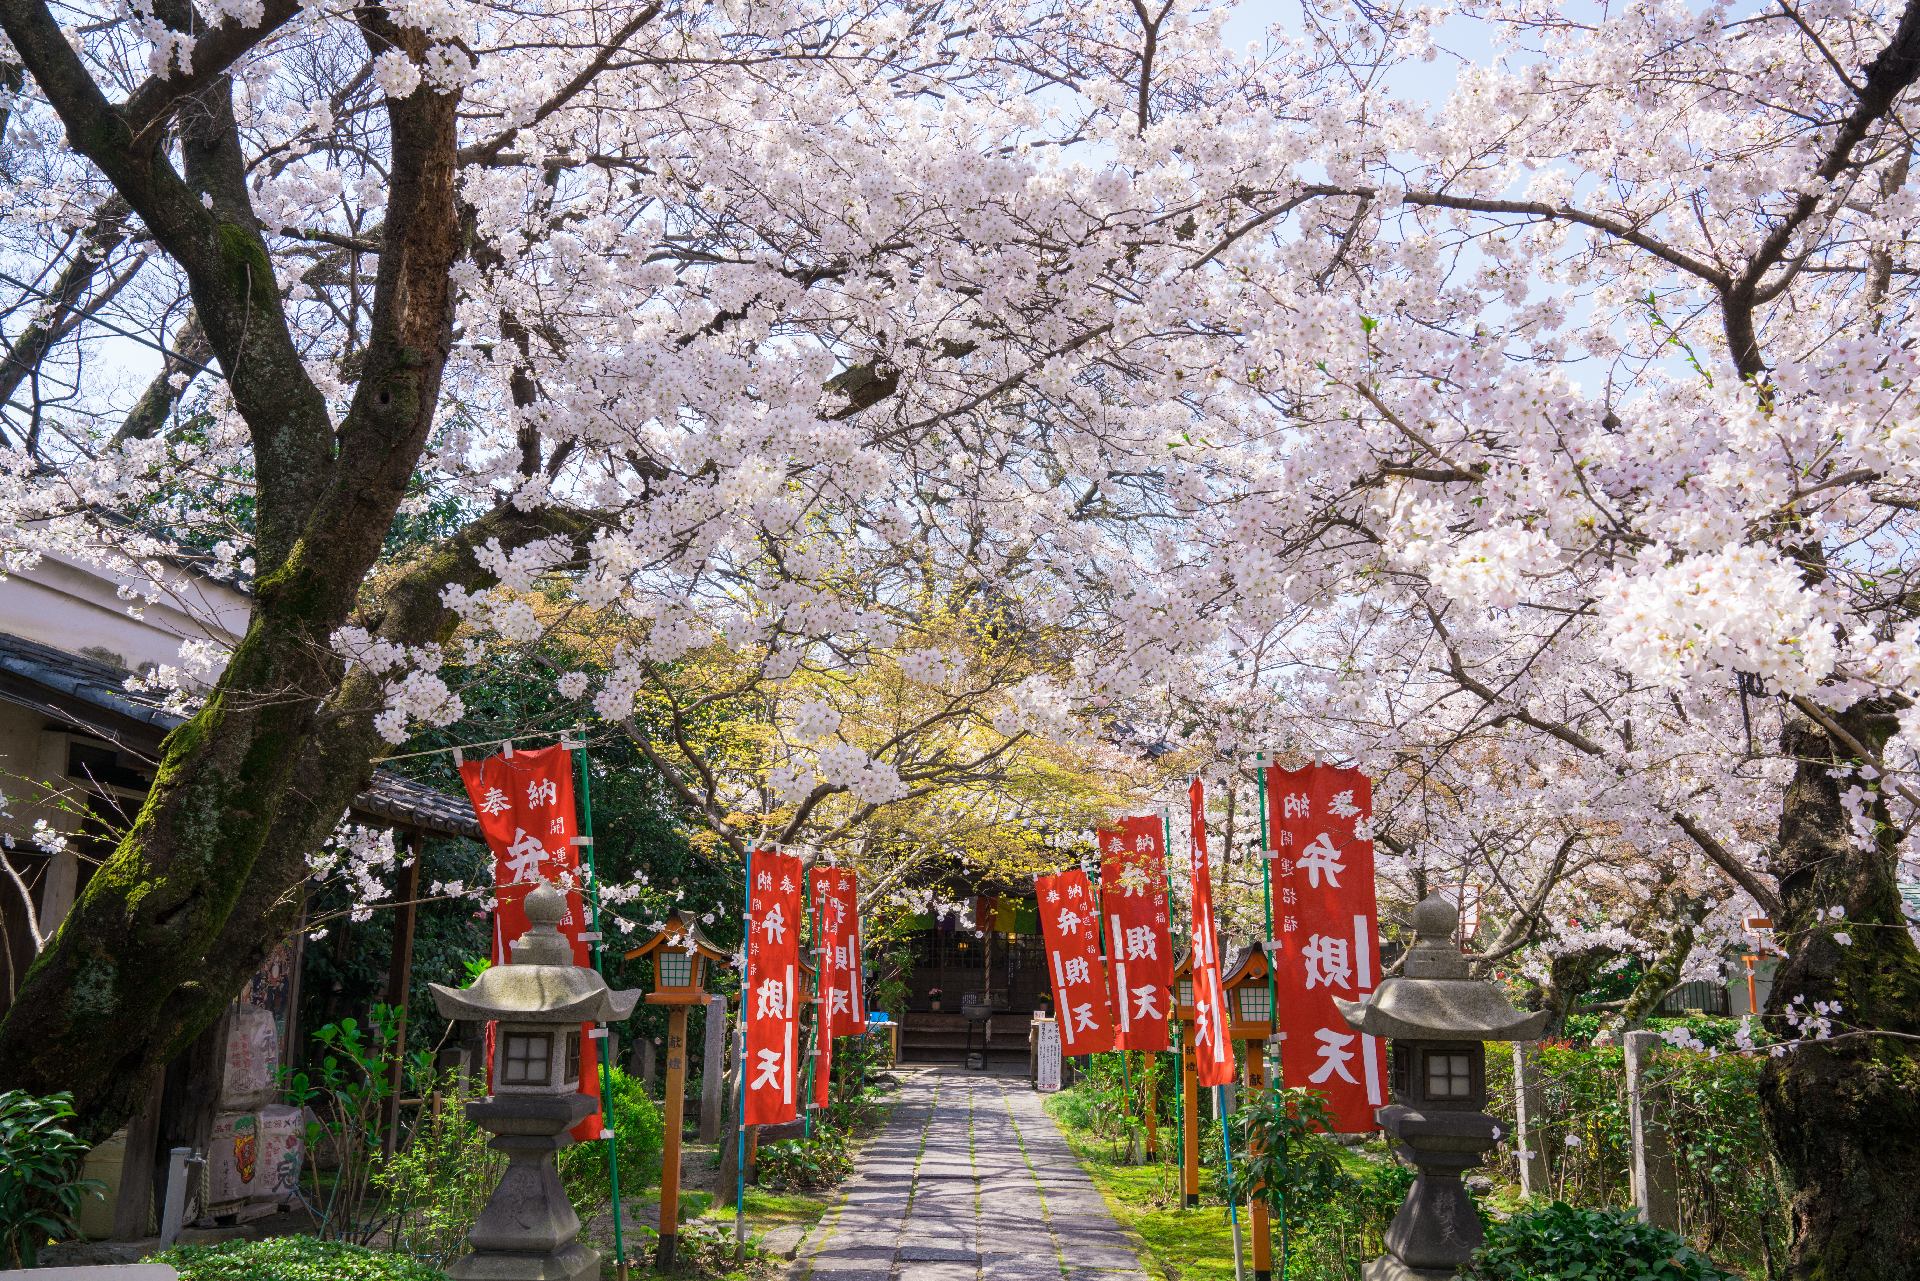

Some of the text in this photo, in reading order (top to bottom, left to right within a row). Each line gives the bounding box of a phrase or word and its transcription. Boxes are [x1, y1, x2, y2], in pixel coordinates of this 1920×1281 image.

[478, 777, 557, 817] 奉納
[550, 816, 574, 926] 開運福
[1108, 833, 1156, 855] 奉納
[1046, 884, 1083, 904] 奉納
[1056, 906, 1101, 1033] 弁財天
[1118, 860, 1163, 1020] 弁財天
